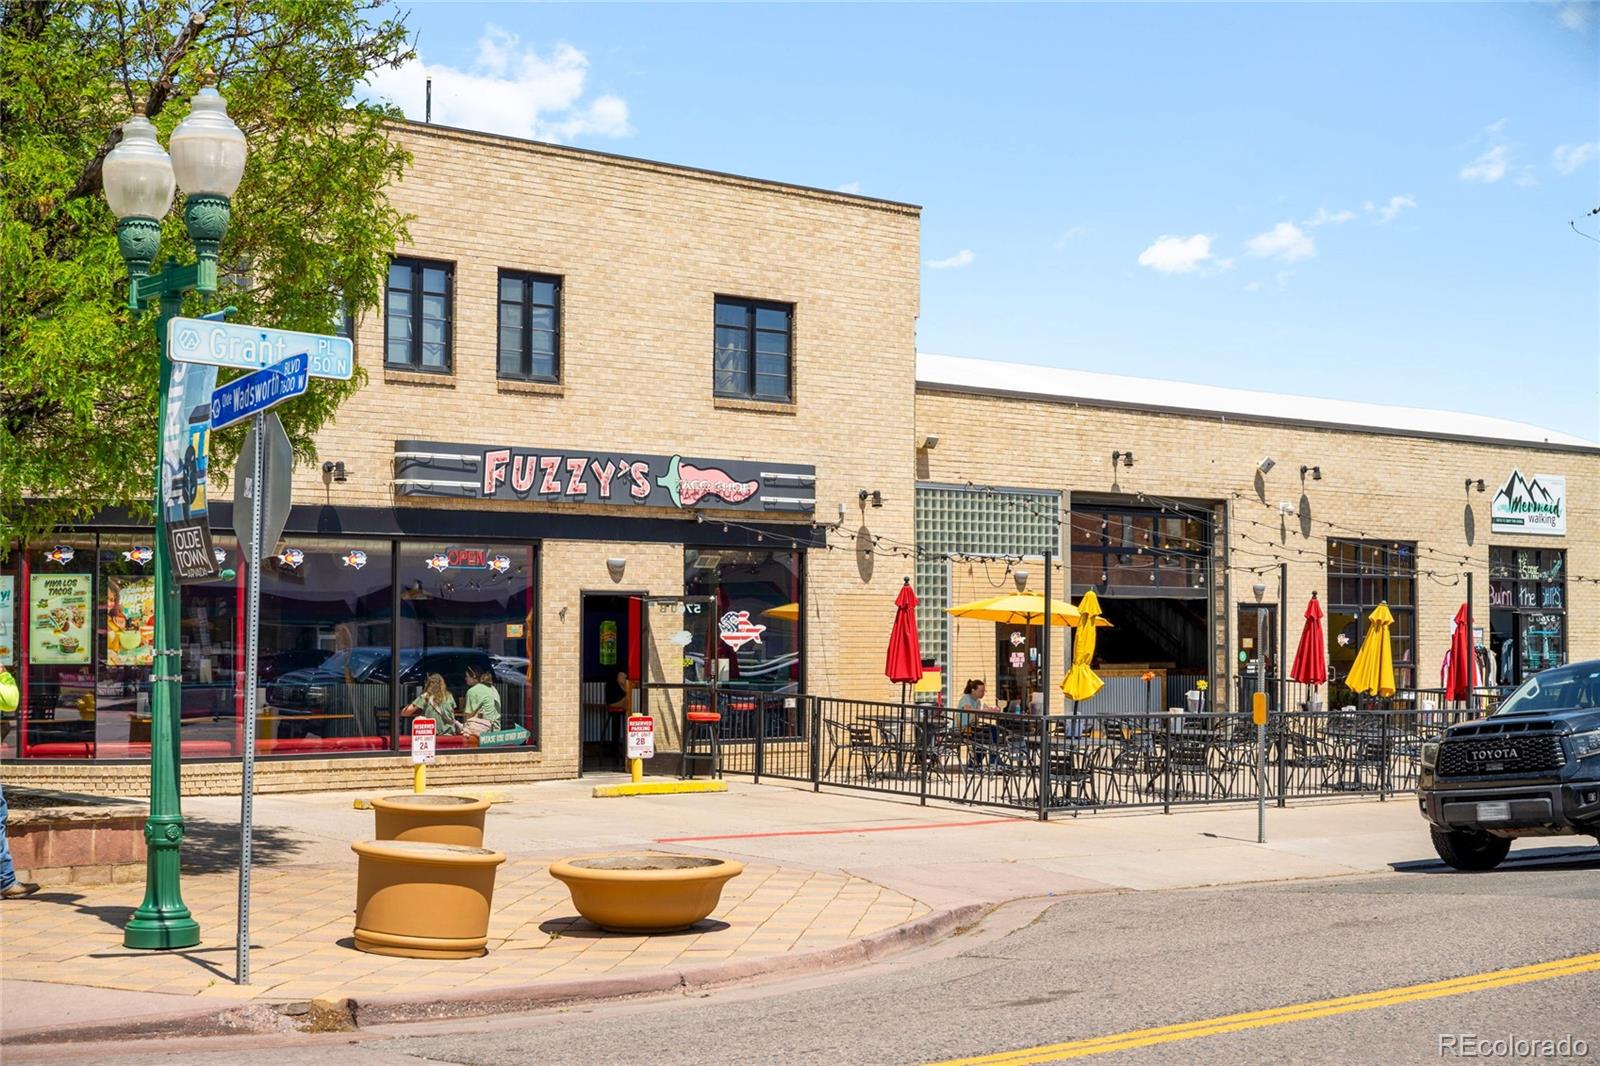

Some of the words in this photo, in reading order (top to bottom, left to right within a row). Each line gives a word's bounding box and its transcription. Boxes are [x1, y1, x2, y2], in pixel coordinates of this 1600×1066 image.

[210, 328, 286, 364] Grant
[318, 339, 335, 356] PL
[284, 358, 301, 376] BLVD
[338, 359, 346, 374] N
[298, 374, 305, 389] W
[222, 392, 232, 407] Olde
[233, 373, 279, 412] Wadsworth
[483, 449, 651, 499] FUZZY'S
[1510, 495, 1561, 518] Mermaid
[1528, 513, 1557, 528] walking
[175, 530, 201, 550] OLDE
[176, 549, 209, 568] TOWN
[448, 549, 486, 566] OPEN
[44, 579, 62, 588] VIVA
[63, 578, 78, 587] LOS
[48, 587, 73, 596] TACOS
[419, 742, 429, 750] 2A
[635, 737, 646, 745] 2B
[1471, 748, 1518, 761] TOYOTA
